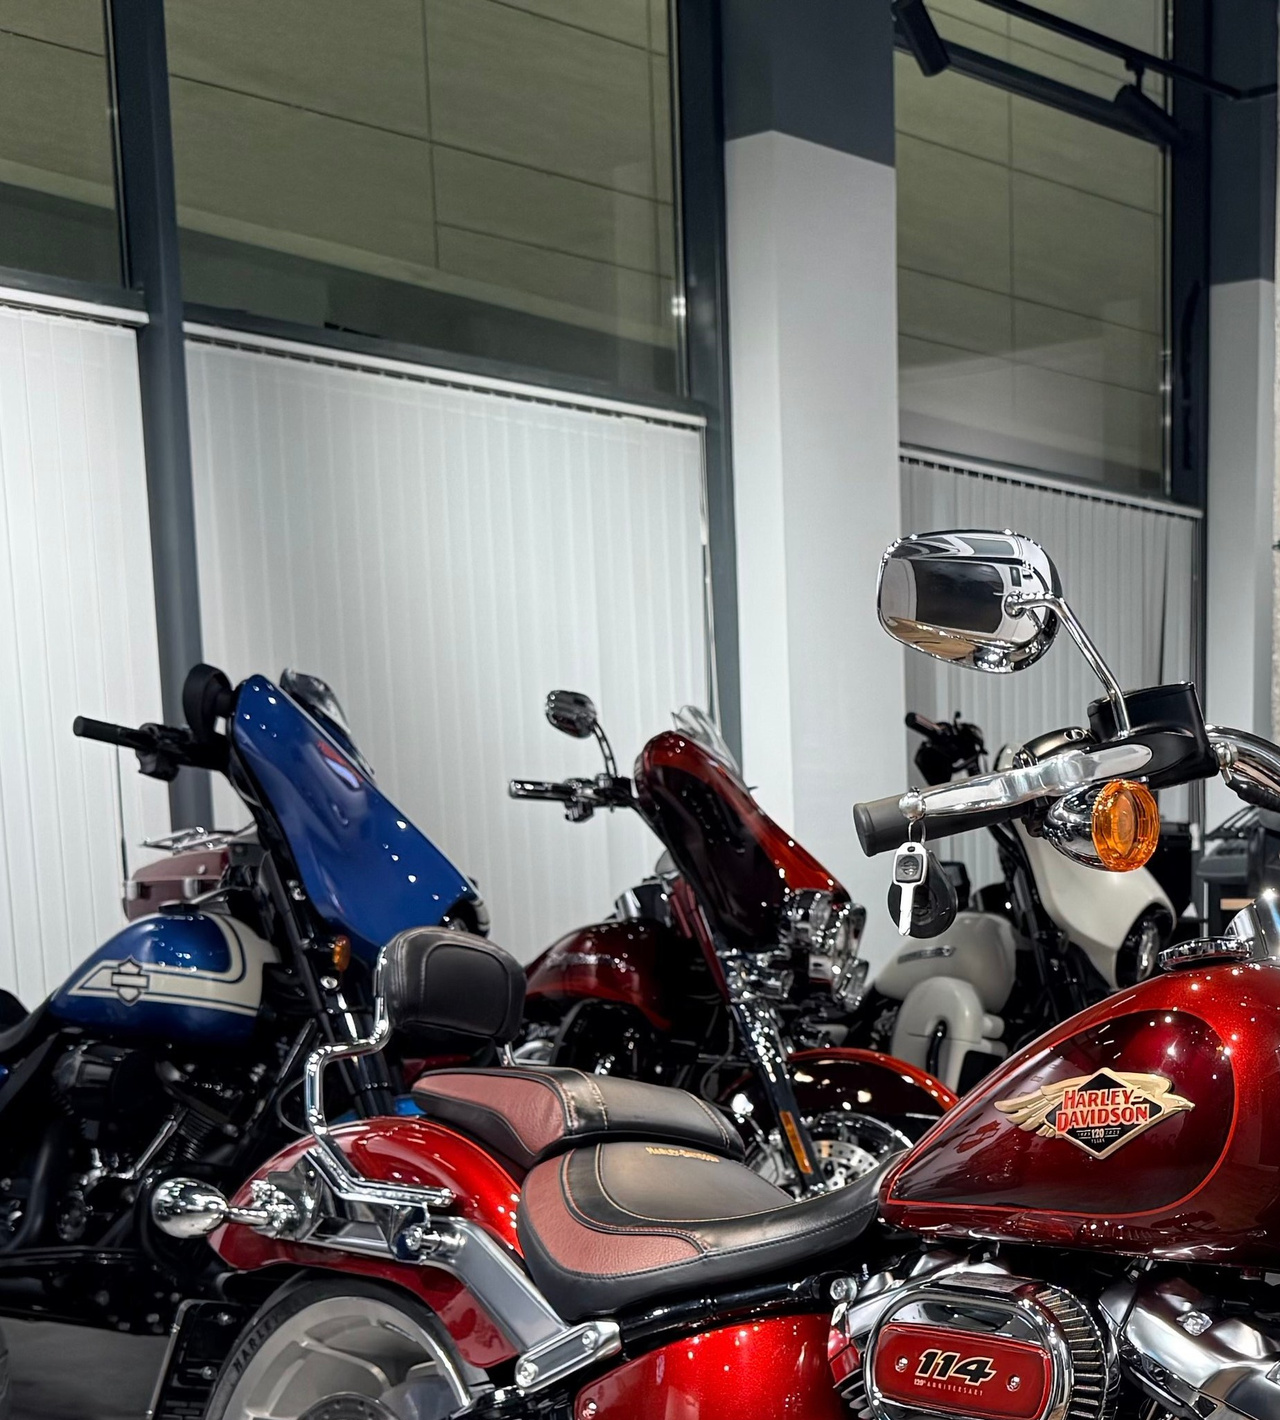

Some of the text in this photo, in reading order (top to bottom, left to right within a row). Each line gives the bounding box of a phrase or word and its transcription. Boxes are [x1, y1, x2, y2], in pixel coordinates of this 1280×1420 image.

[1063, 1087, 1145, 1111] HARLEY-
[1056, 1104, 1149, 1133] DAVIDSON
[1091, 1128, 1105, 1139] 120
[914, 1348, 998, 1387] 114
